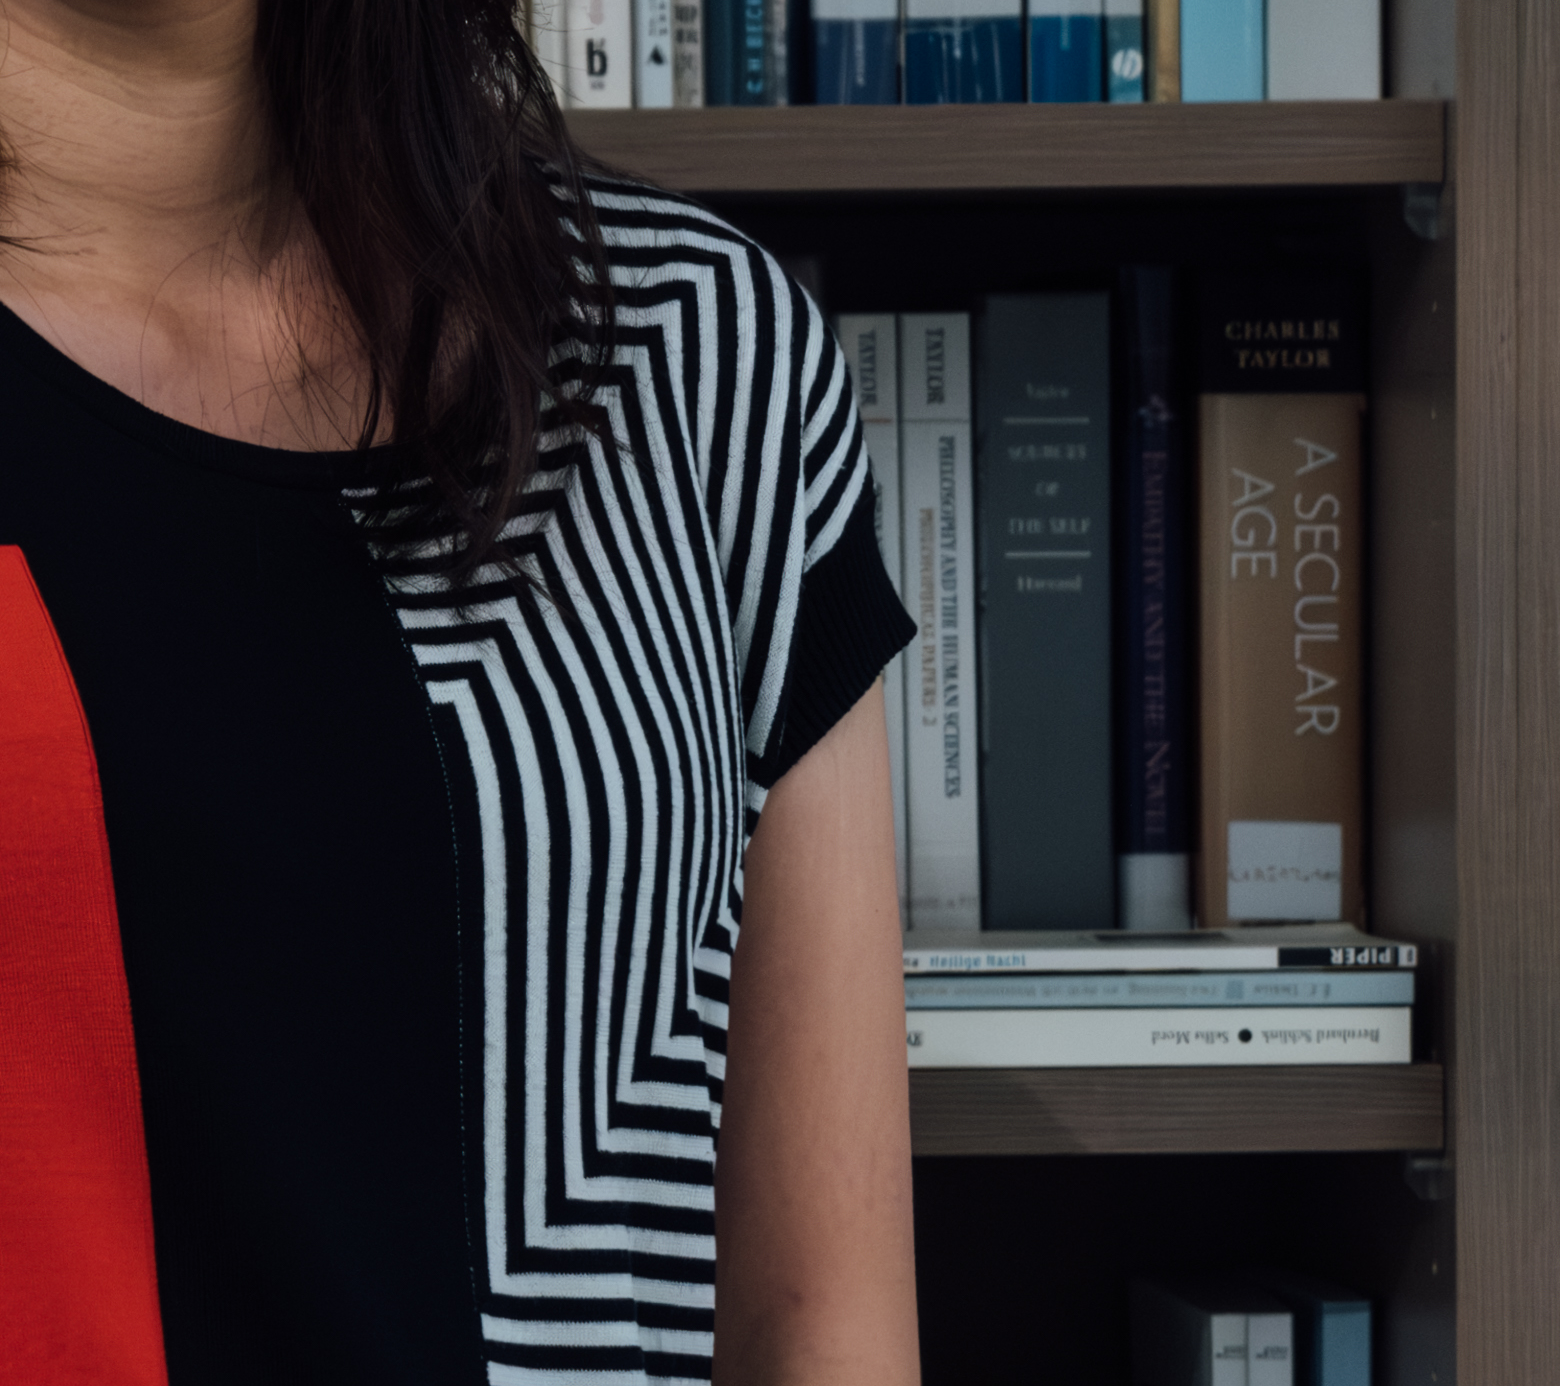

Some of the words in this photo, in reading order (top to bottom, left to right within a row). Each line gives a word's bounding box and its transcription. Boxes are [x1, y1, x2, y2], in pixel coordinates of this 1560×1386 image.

[1225, 319, 1340, 341] CHARLES
[1233, 348, 1331, 370] TAYLOR
[858, 330, 877, 406] TAYLOR
[926, 327, 945, 405] TAYLOR
[1293, 437, 1339, 476] A
[938, 435, 957, 552] PHILOSOPHY
[1143, 450, 1167, 586] EMPATHY
[1229, 467, 1277, 579] AGE
[939, 555, 958, 591] AND
[940, 595, 959, 632] THE
[1143, 601, 1167, 660] AND
[1293, 492, 1339, 736] SECULAR
[941, 635, 960, 708] HUMAN
[1143, 664, 1167, 726] THE
[942, 711, 961, 799] SCIENCES
[1143, 740, 1171, 834] NOVEL
[1329, 946, 1392, 966] PIPER
[1151, 1027, 1190, 1044] Mord
